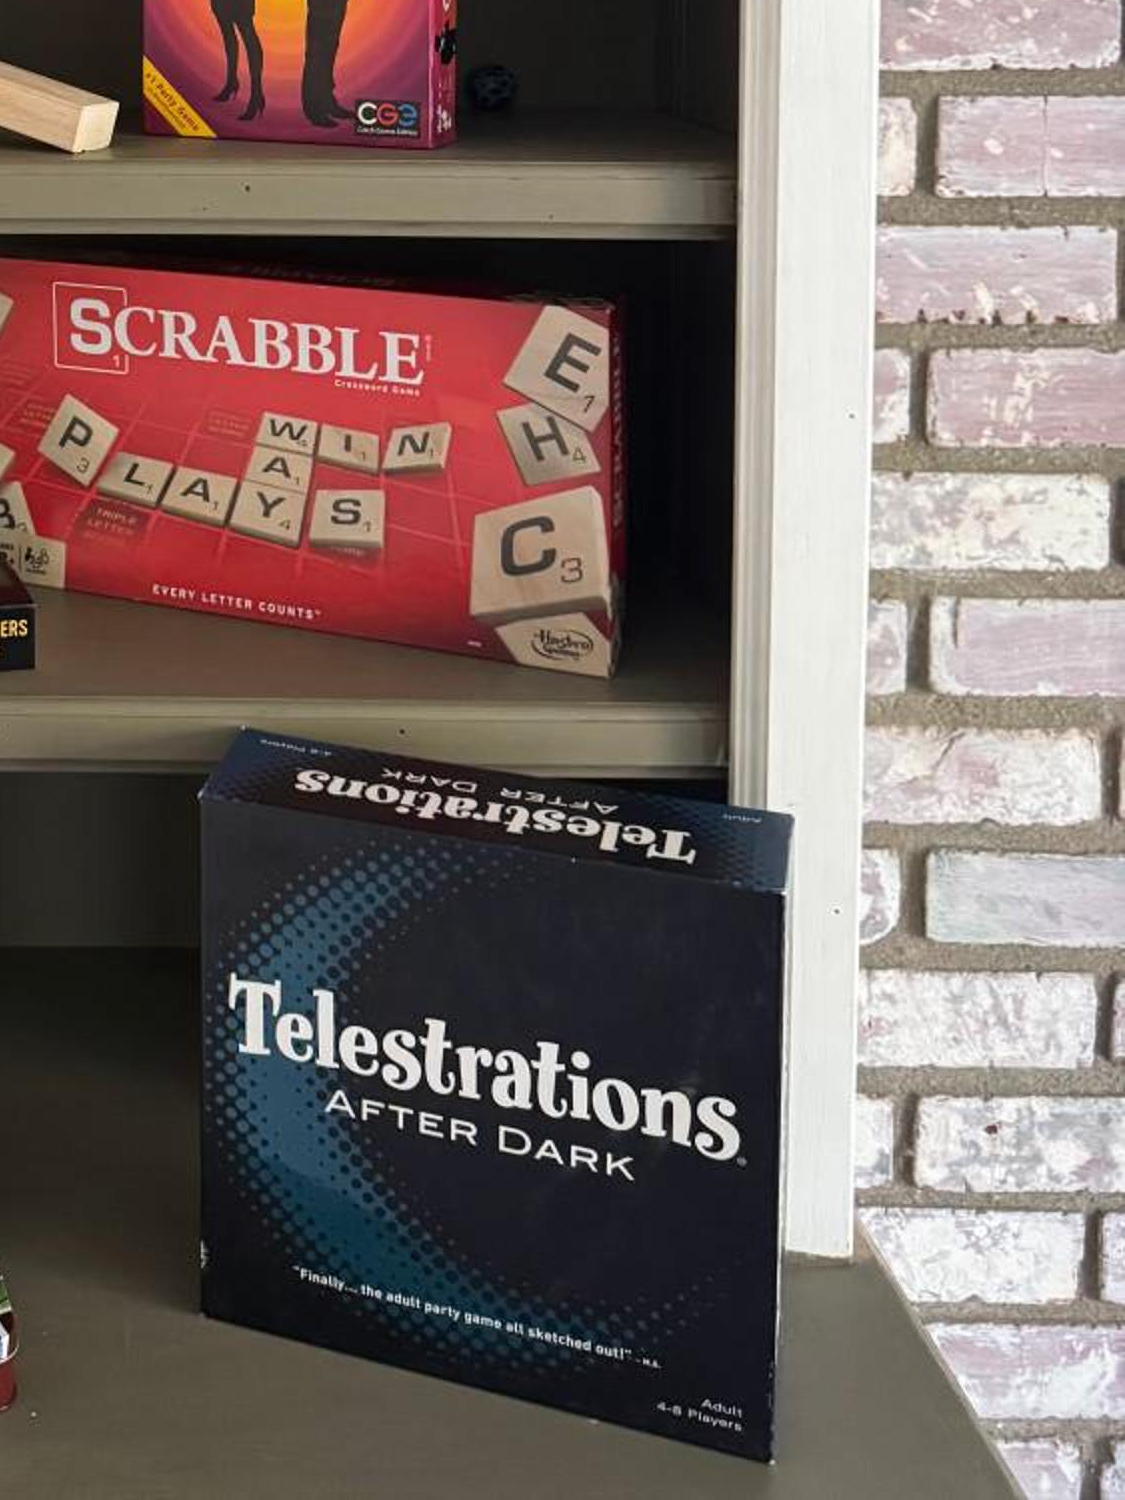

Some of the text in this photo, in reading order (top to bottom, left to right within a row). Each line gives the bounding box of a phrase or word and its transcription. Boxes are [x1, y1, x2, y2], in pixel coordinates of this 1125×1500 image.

[70, 297, 424, 386] SCRABBLE
[334, 379, 420, 397] Crossword Game
[152, 583, 197, 599] EVERY
[201, 592, 253, 610] LETTER
[294, 769, 697, 865] Telestrations
[381, 767, 619, 815] AFTER DARK
[228, 971, 742, 1162] Telestrations
[324, 1088, 636, 1182] AFTER DARK
[360, 1284, 383, 1300] the
[386, 1292, 421, 1309] adult
[424, 1301, 462, 1322] party
[464, 1311, 503, 1329] game
[506, 1322, 525, 1336] all
[527, 1326, 593, 1352] sketched
[688, 1407, 743, 1432] Players
[701, 1399, 743, 1419] Adult
